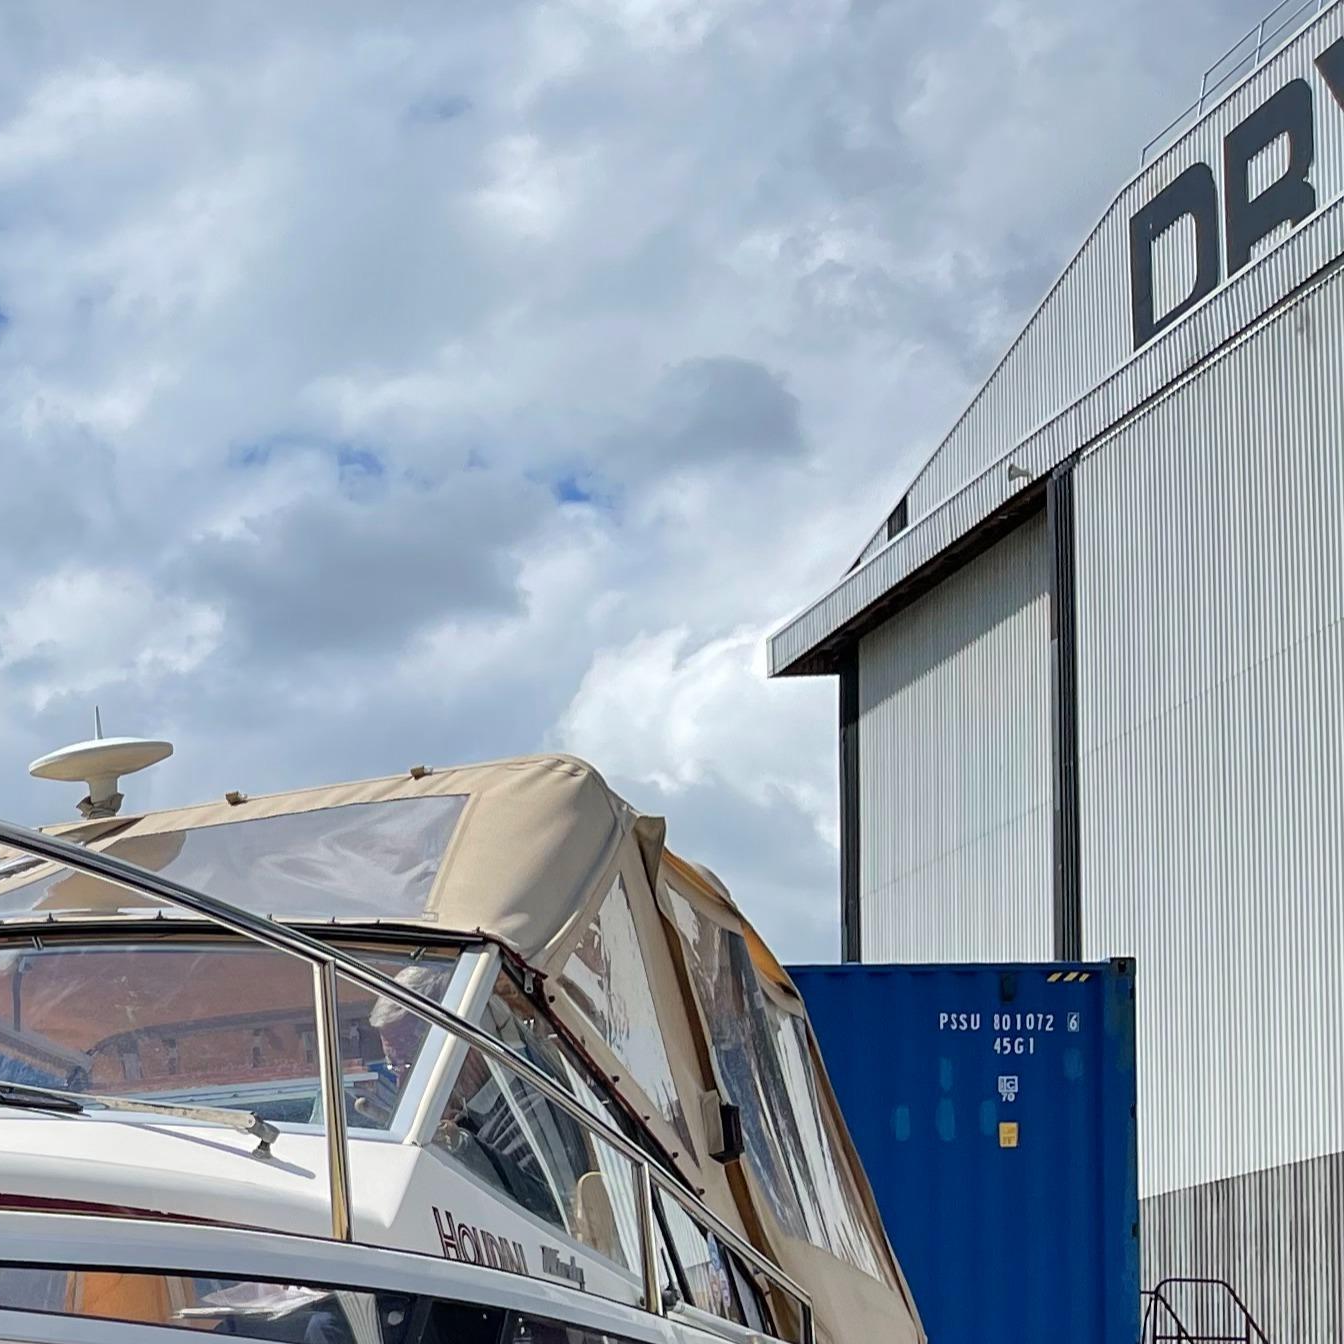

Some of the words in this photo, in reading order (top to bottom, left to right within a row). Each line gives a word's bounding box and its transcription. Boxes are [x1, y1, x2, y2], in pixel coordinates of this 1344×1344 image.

[939, 1012, 981, 1031] PSSU
[993, 1013, 1055, 1032] 801072
[1067, 1012, 1080, 1033] 6
[993, 1037, 1035, 1055] 45G1
[1000, 1092, 1016, 1103] 70
